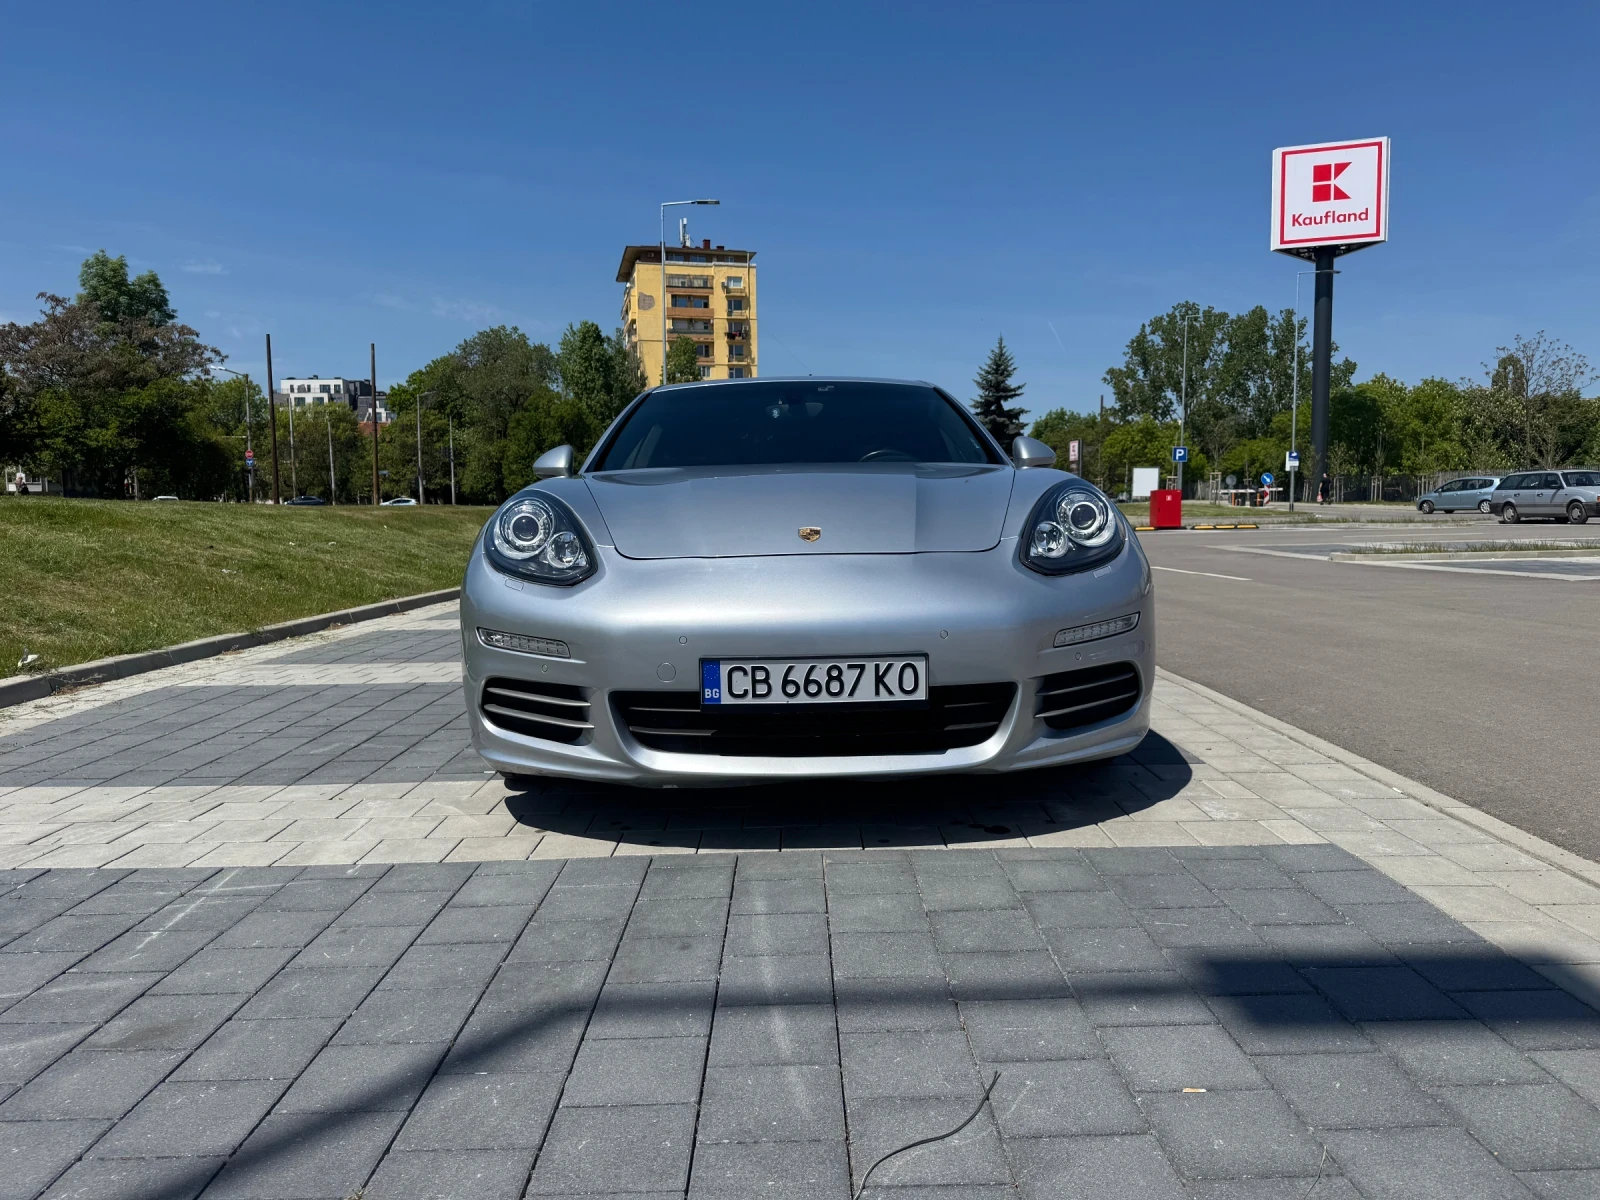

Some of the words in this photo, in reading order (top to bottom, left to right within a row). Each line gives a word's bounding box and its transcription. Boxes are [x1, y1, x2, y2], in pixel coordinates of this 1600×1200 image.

[1312, 161, 1352, 202] K
[1291, 207, 1369, 227] Kaufland
[1176, 449, 1184, 460] P
[727, 665, 772, 699] CB
[781, 664, 866, 698] 6687
[874, 662, 919, 697] KO
[704, 688, 720, 698] BG
